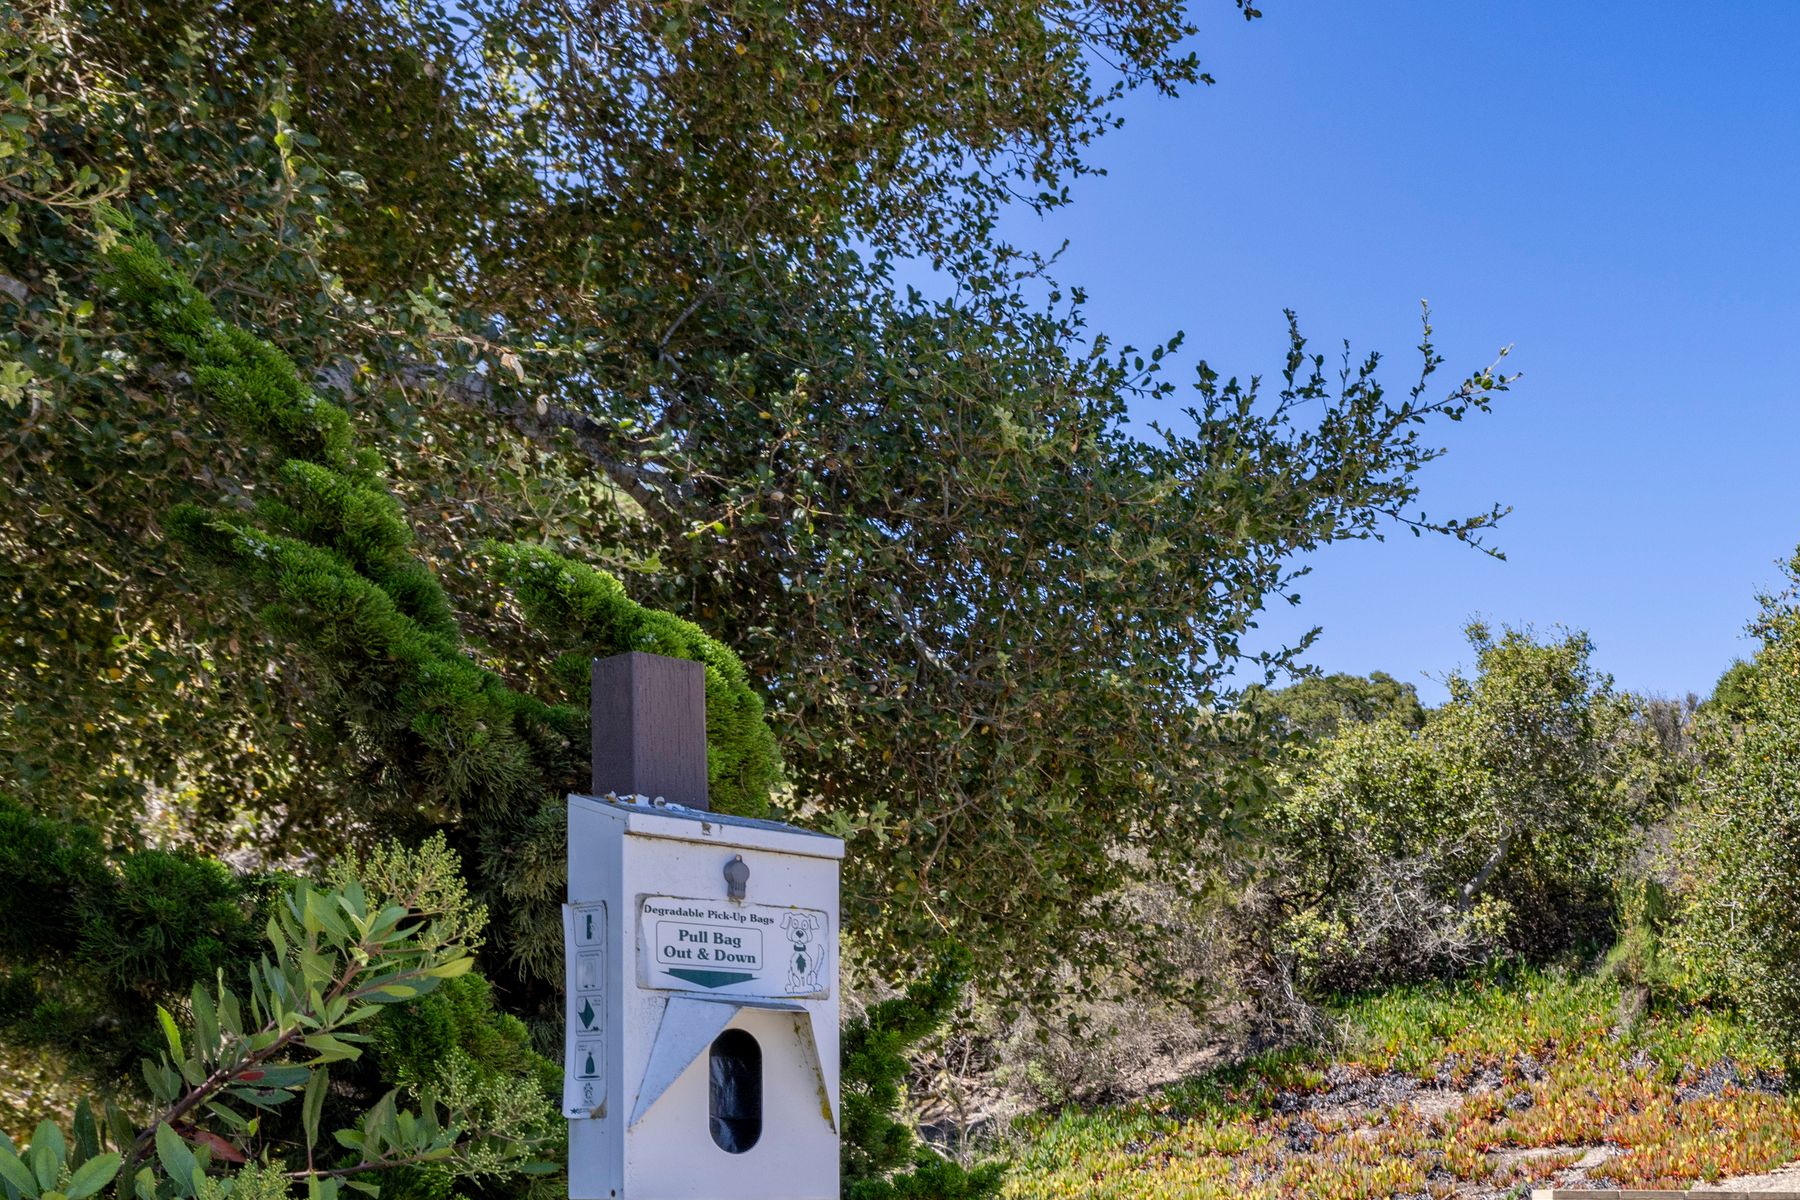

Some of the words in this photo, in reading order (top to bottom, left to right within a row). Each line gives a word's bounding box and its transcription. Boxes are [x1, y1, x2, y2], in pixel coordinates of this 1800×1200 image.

[644, 904, 704, 918] Degradable
[708, 910, 747, 923] Pick-Up
[750, 914, 775, 925] Bags
[679, 929, 708, 943] Pull
[714, 932, 741, 948] Bag
[663, 945, 692, 959] Out
[697, 948, 709, 960] &
[715, 949, 756, 964] Down
